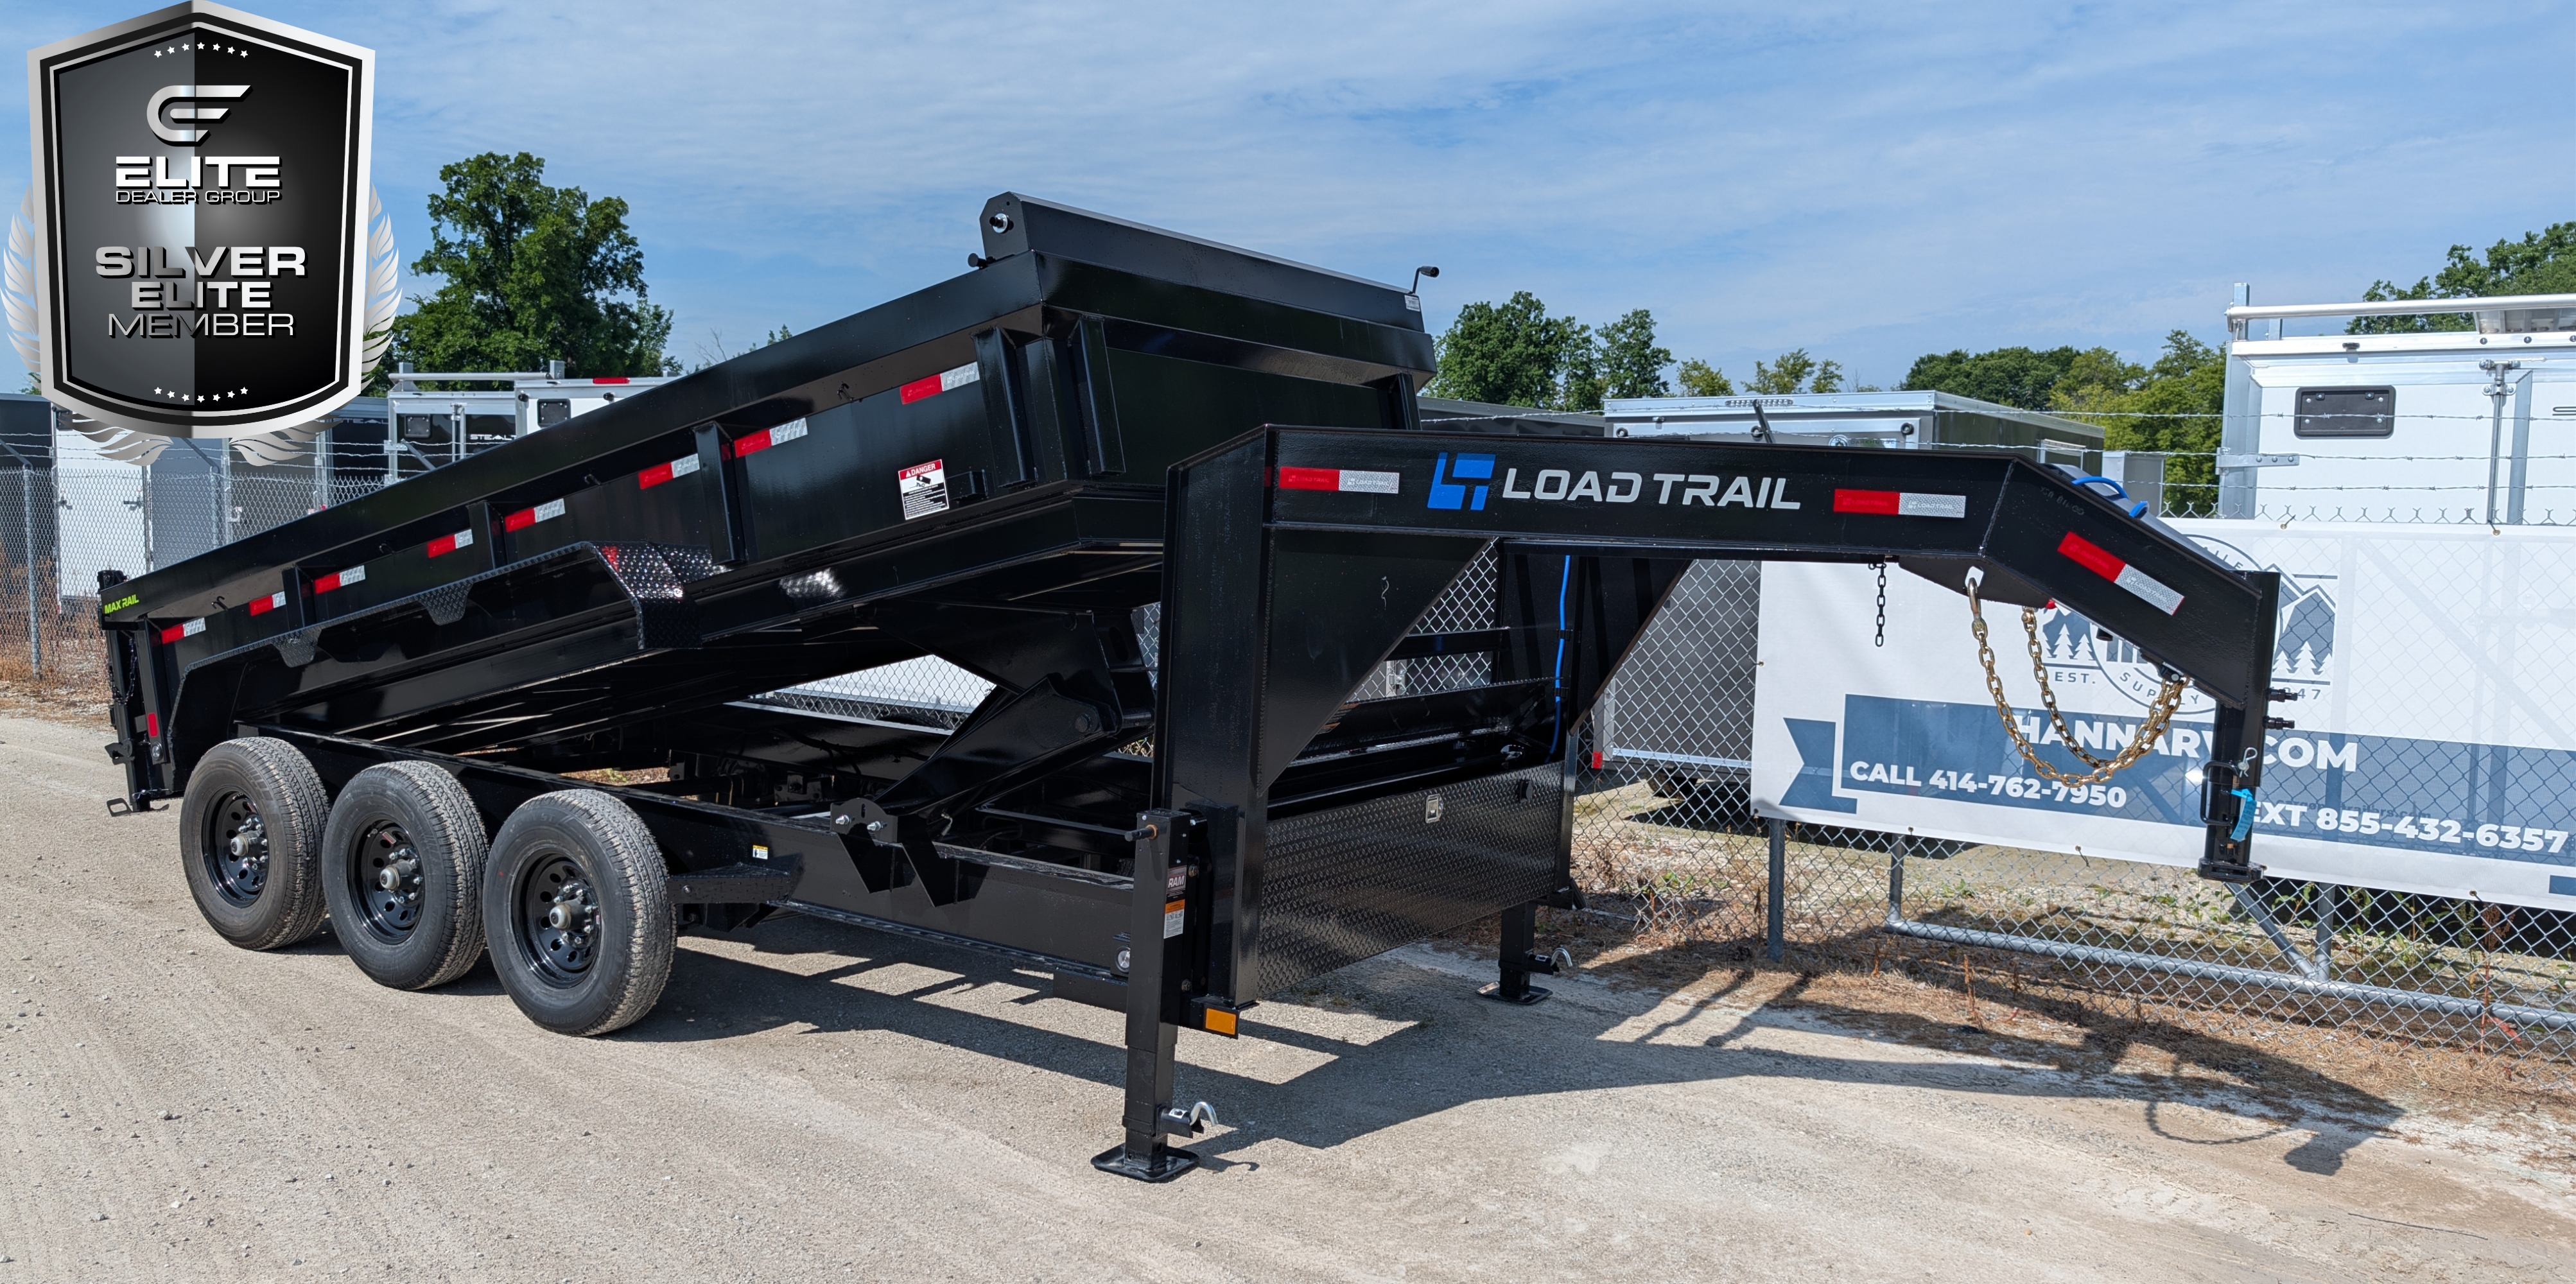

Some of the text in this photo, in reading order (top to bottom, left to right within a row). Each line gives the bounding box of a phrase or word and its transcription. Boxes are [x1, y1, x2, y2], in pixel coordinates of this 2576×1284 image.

[911, 463, 936, 476] DANGER
[1502, 468, 1642, 503] LOAD
[1653, 473, 1800, 510] TRAIL
[104, 594, 139, 614] MAX RAIL
[2054, 671, 2096, 684] EST.
[2119, 672, 2200, 706] SUPY
[1849, 761, 2127, 808] CALL 414-762-7950
[2253, 801, 2308, 827] EXT
[2316, 807, 2569, 854] 855-432-6357
[1167, 875, 1185, 889] RAM
